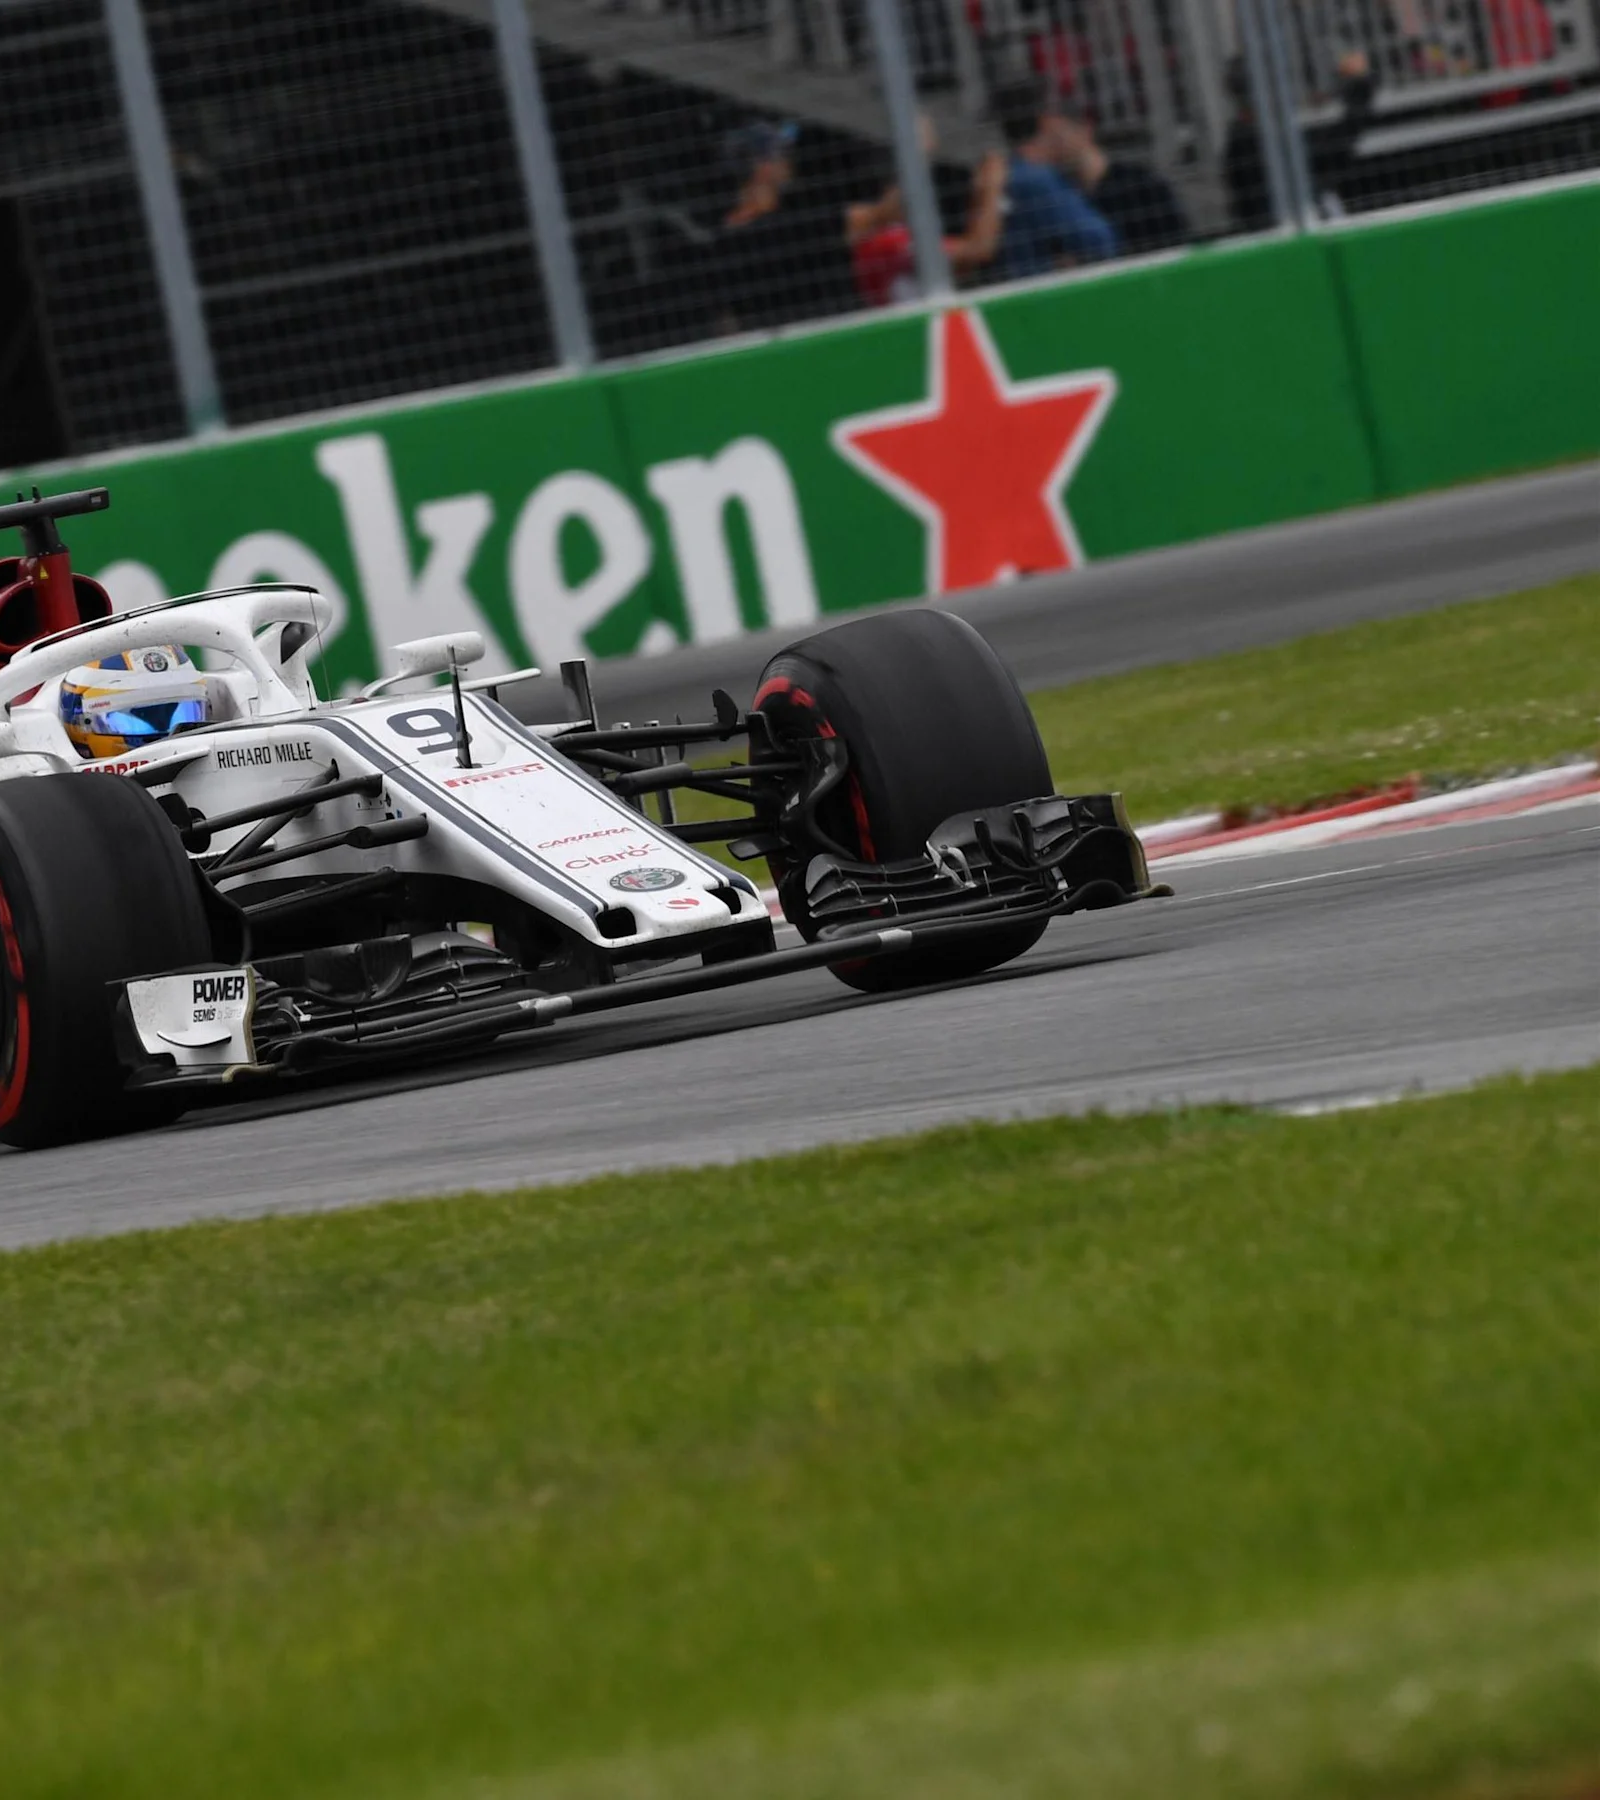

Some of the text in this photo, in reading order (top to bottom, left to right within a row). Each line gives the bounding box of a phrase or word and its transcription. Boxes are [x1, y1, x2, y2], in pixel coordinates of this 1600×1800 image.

[385, 708, 462, 755] 9
[217, 741, 313, 769] RICHARD MILLE
[443, 763, 545, 788] PIRELLI
[537, 826, 633, 850] CARRERA
[565, 845, 650, 870] Claro
[193, 976, 245, 1004] POWER
